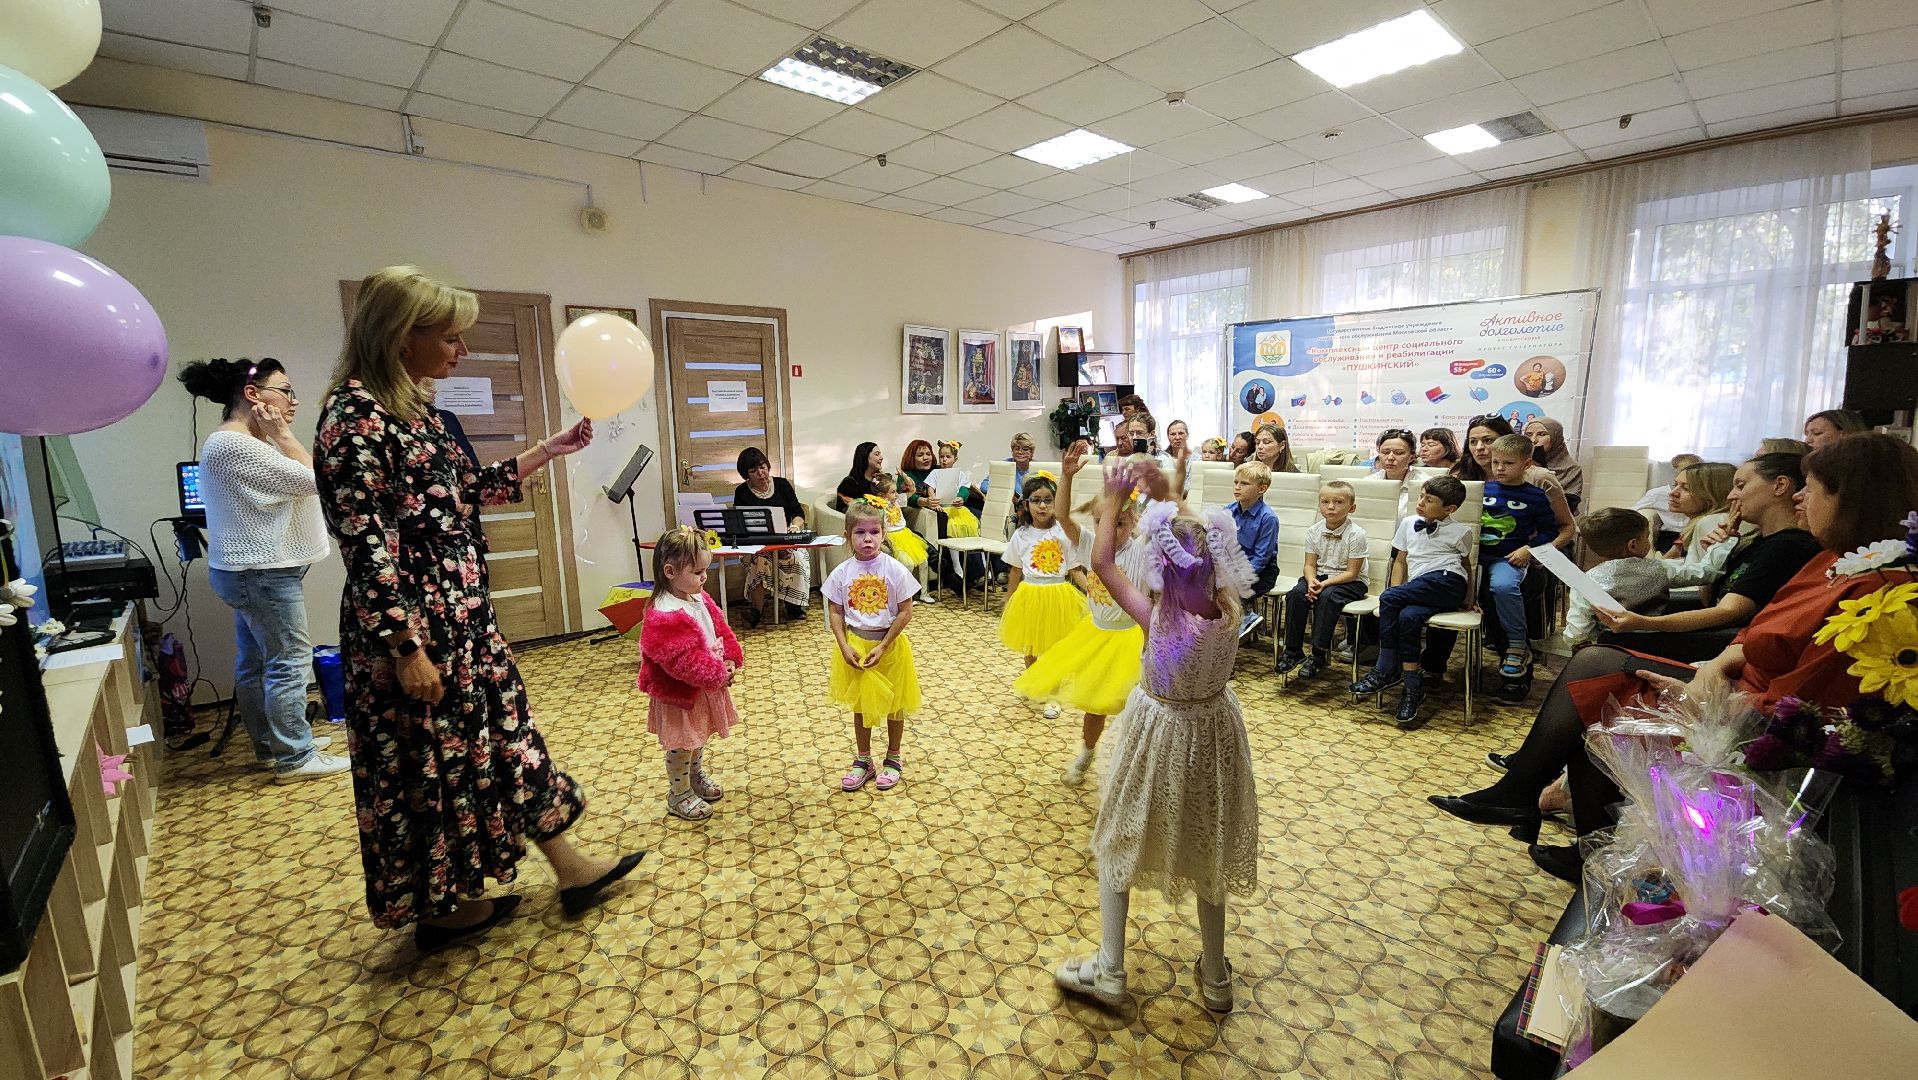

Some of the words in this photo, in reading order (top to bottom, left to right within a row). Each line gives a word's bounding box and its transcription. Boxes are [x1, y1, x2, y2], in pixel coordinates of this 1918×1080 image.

[1480, 311, 1563, 327] Активное
[1480, 324, 1565, 337] долголетие
[1372, 342, 1399, 352] центр
[1401, 339, 1463, 350] социального
[1313, 353, 1376, 364] обслуживания
[1386, 349, 1454, 360] реабилитации
[1342, 360, 1420, 372] «ПУШКИНСКИЙ»
